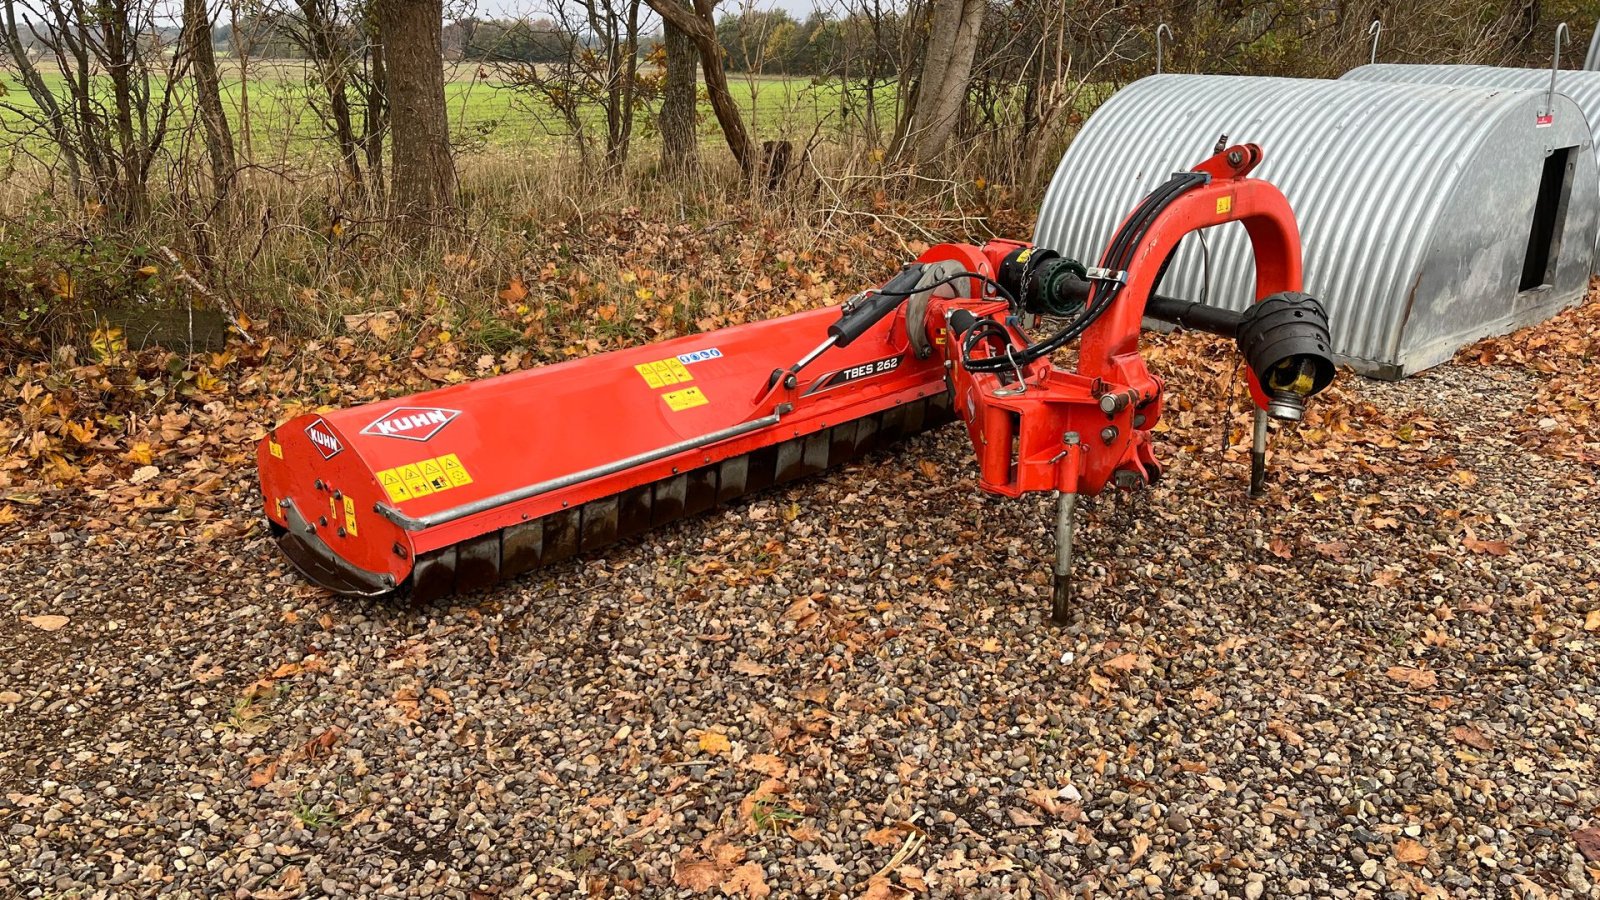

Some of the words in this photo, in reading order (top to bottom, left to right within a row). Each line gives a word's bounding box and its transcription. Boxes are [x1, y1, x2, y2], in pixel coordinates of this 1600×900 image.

[844, 364, 873, 380] TBES
[876, 358, 898, 372] 262
[376, 410, 447, 434] KUHN
[310, 428, 338, 451] KUHN
